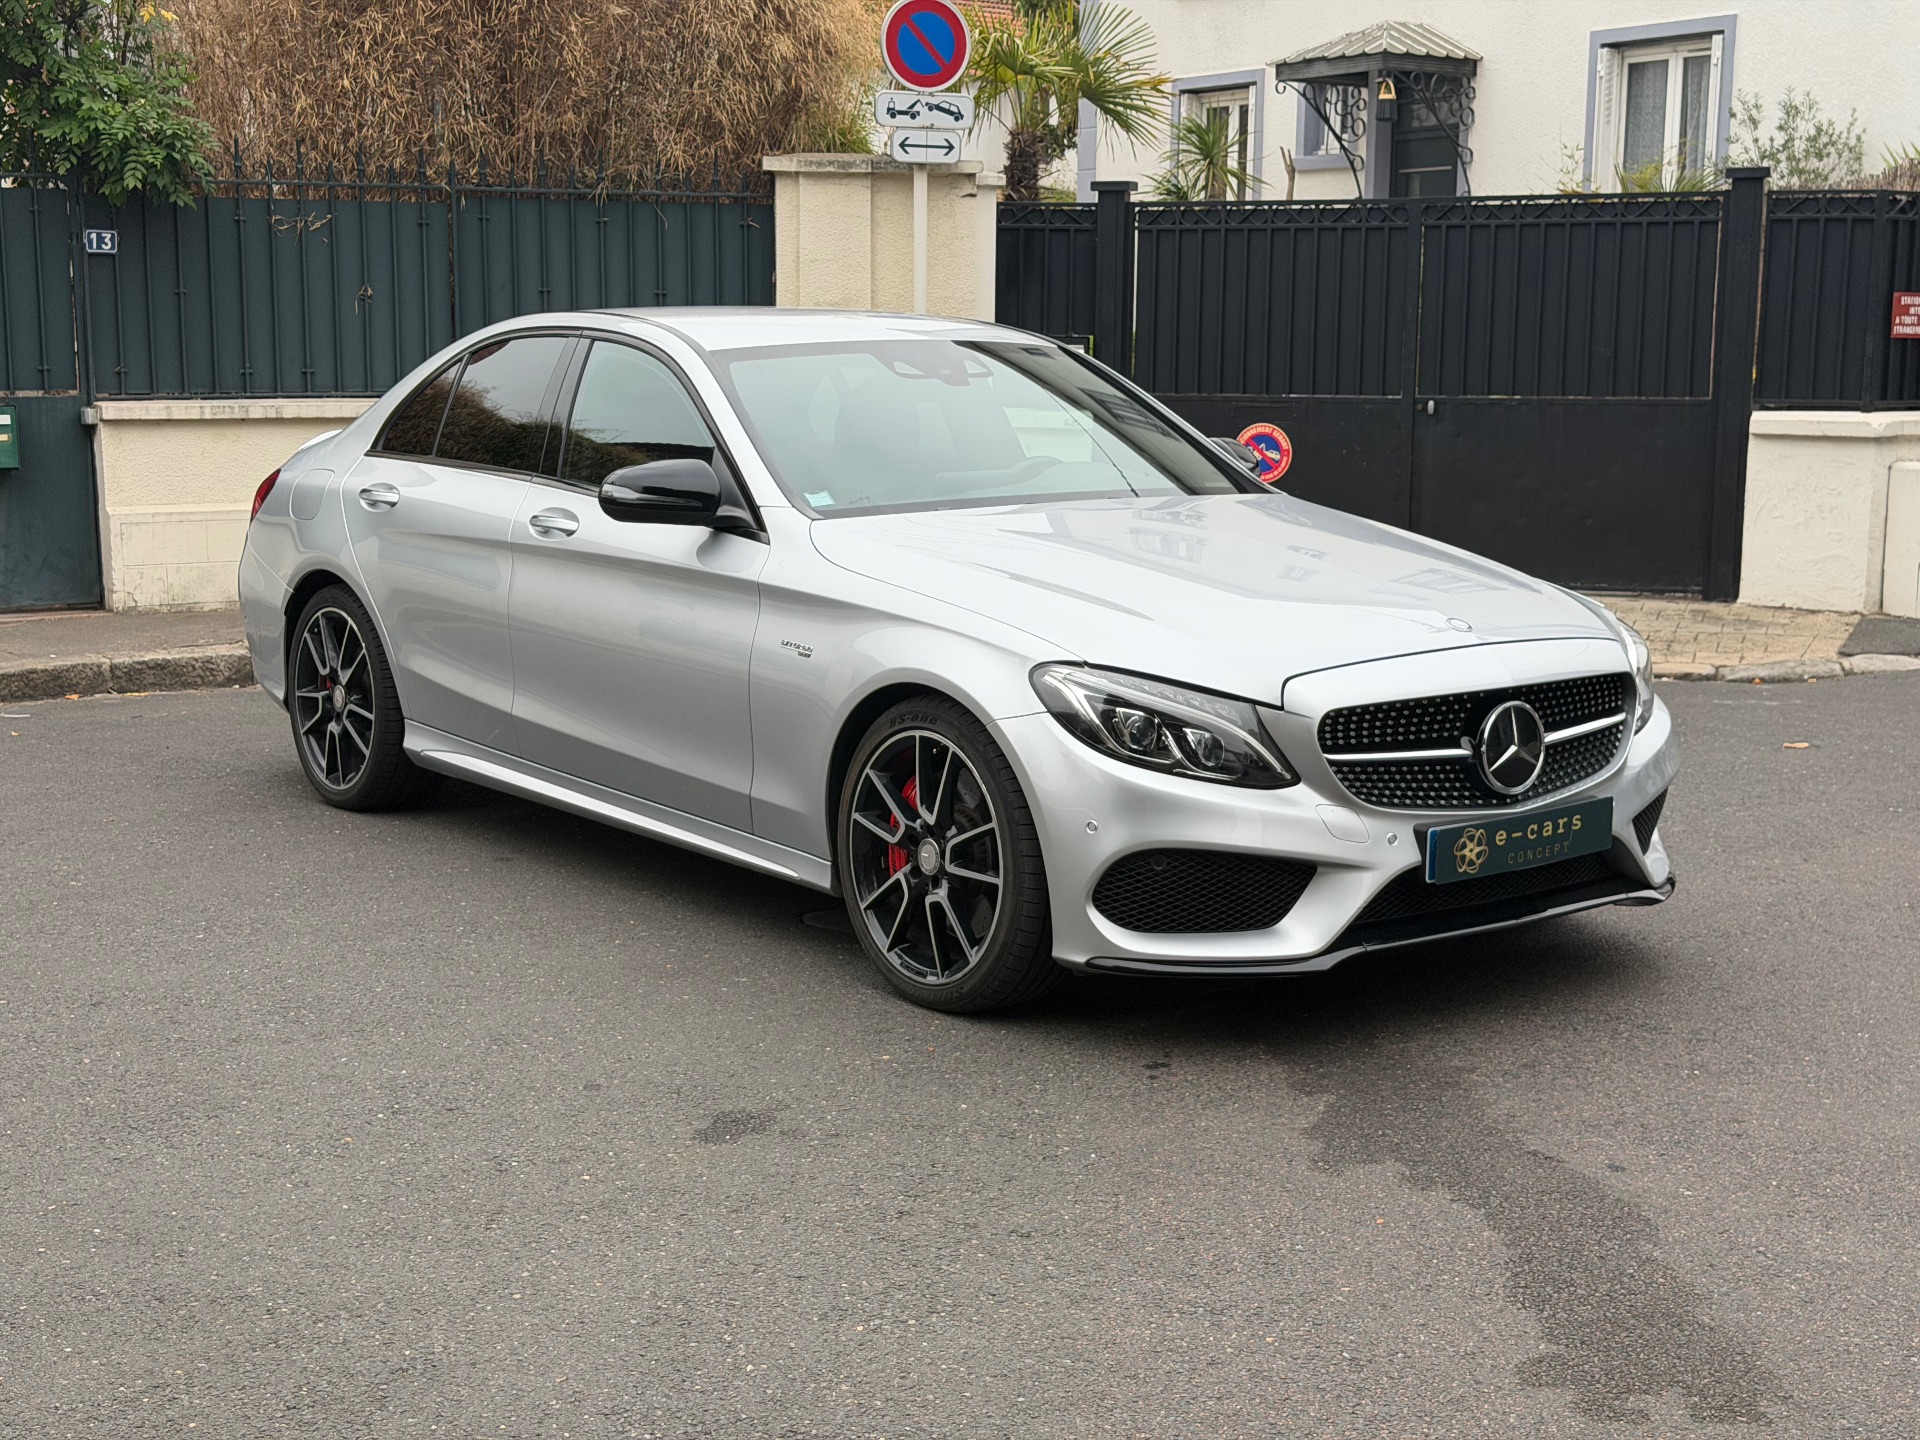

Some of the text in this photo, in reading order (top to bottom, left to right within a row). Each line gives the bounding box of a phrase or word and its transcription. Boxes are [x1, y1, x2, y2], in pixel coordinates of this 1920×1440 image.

[90, 232, 112, 250] 13
[1895, 315, 1919, 324] A TOUTE
[1495, 814, 1582, 846] e-cars
[1508, 841, 1570, 864] CONCEPT
